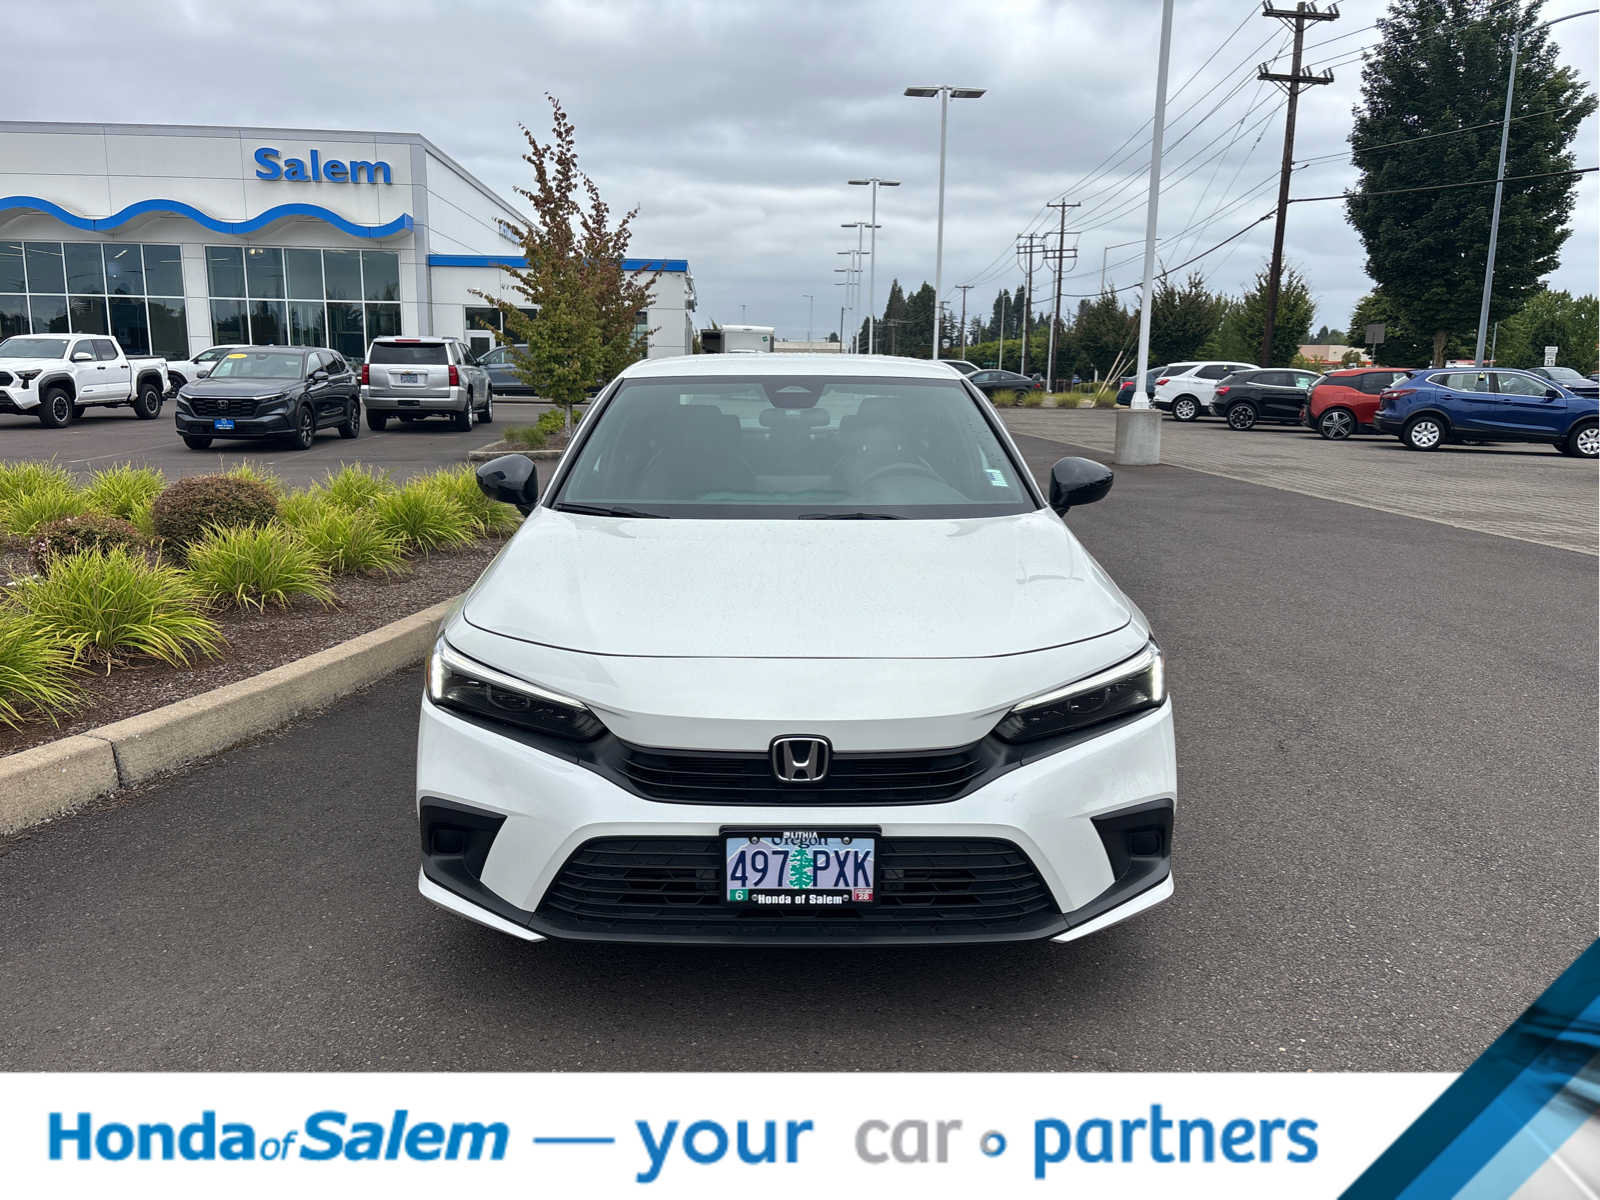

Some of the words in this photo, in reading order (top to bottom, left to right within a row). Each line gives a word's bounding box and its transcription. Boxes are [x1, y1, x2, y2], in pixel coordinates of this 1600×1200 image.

[254, 147, 392, 185] Salem
[730, 850, 790, 888] 497
[812, 850, 871, 888] PXK
[735, 891, 744, 901] 6
[758, 894, 792, 905] Honda
[795, 894, 806, 905] of
[809, 894, 843, 905] Salem
